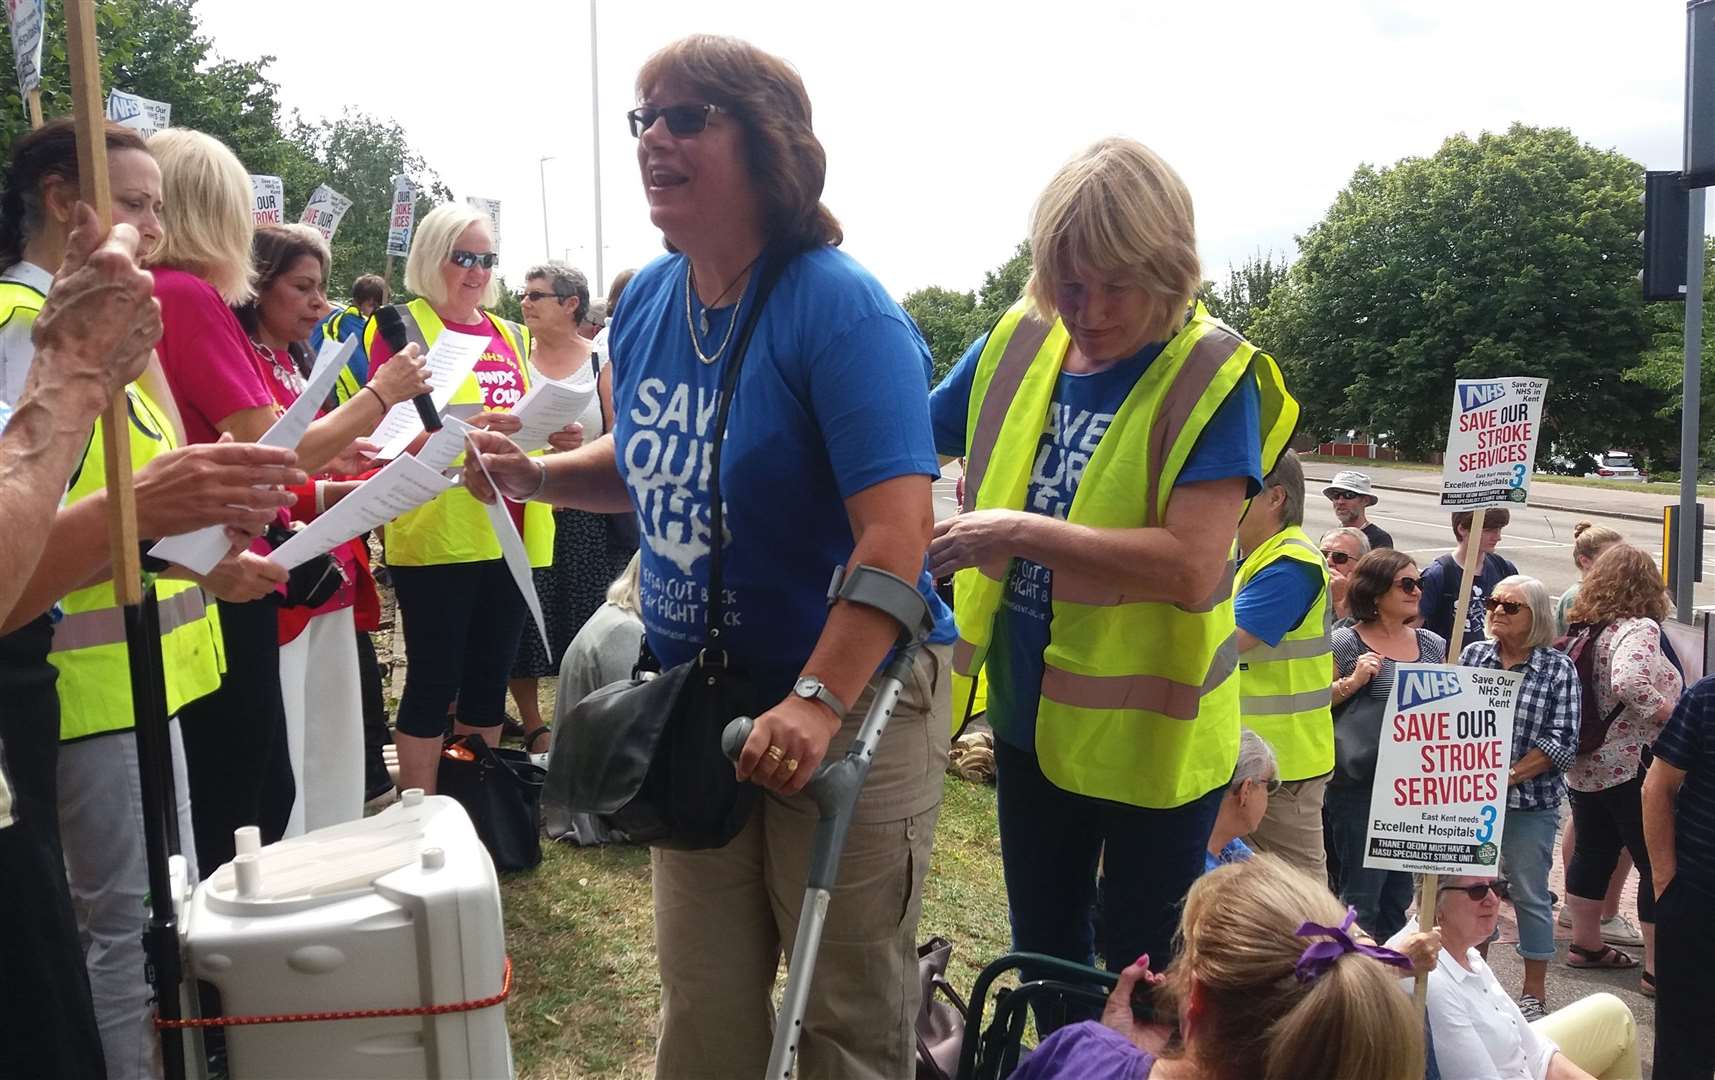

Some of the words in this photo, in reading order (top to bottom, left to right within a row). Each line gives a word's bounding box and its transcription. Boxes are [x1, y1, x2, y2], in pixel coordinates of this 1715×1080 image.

[111, 94, 140, 121] NHS
[257, 195, 276, 209] OUR
[398, 191, 410, 203] OUR
[252, 209, 280, 225] TROKE
[477, 370, 517, 387] ANDS
[1529, 381, 1542, 389] Our
[630, 377, 724, 436] SAV
[1466, 384, 1505, 408] NHS
[1044, 400, 1115, 451] AVE
[1459, 409, 1497, 433] SAVE
[1501, 404, 1528, 425] OUR
[1478, 423, 1532, 449] STROKE
[1029, 444, 1089, 493] UR
[1459, 444, 1527, 473] SERVICES
[1479, 478, 1508, 487] Hospitals
[1509, 464, 1527, 487] 3
[666, 578, 697, 601] CUT
[701, 587, 737, 605] BCK
[658, 594, 699, 624] FIGHT
[1400, 671, 1462, 707] NHS
[1472, 673, 1494, 685] Save
[1496, 676, 1515, 687] Our
[1478, 686, 1500, 697] NHS
[1502, 687, 1512, 698] in
[1488, 697, 1510, 709] Kent
[1393, 712, 1450, 742] SAVE
[1456, 709, 1496, 739] OUR
[1421, 741, 1503, 773] STROKE
[1394, 773, 1498, 806] SERVICES
[1373, 820, 1424, 835] Excellent
[1428, 825, 1475, 838] Hospitals
[1421, 812, 1438, 821] East
[1440, 814, 1456, 822] Kent
[1458, 816, 1479, 824] needs
[1475, 805, 1497, 842] 3
[1372, 848, 1392, 857] HASU
[1392, 849, 1433, 861] SPECIALIST
[1433, 851, 1458, 862] STROKE
[1458, 853, 1474, 863] UNIT
[1378, 839, 1405, 850] THANET
[1428, 842, 1447, 853] MUST
[1447, 844, 1464, 853] HAVE
[1465, 845, 1471, 853] A
